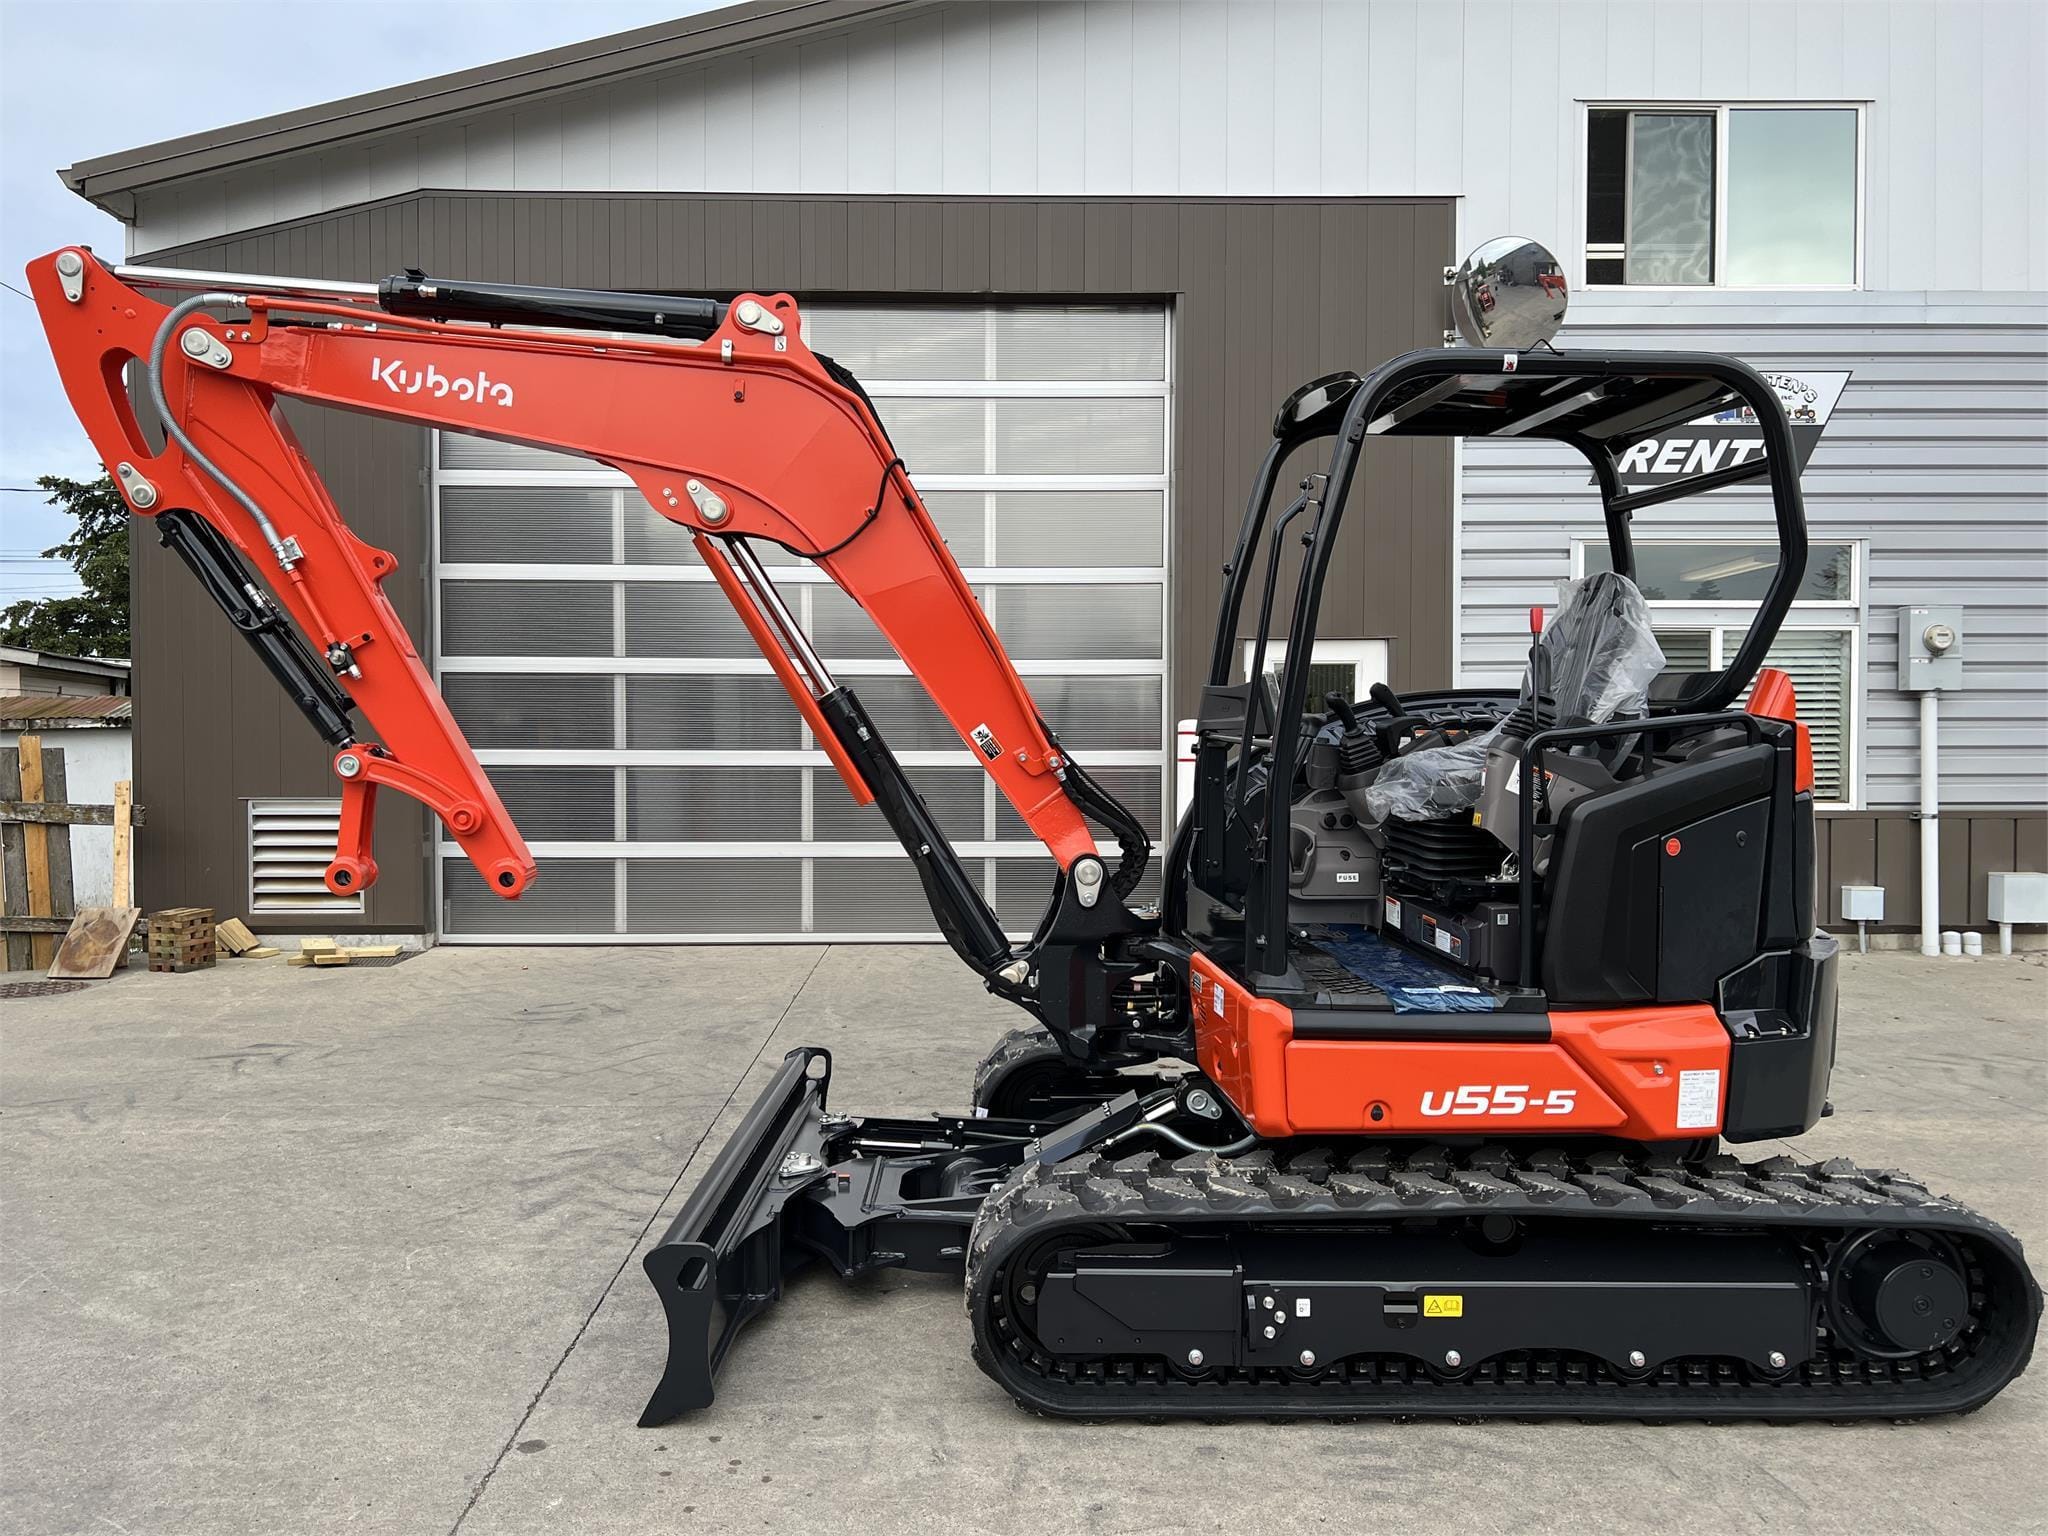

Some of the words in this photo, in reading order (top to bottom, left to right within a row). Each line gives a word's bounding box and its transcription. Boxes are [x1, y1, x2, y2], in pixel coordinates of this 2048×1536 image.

[371, 357, 514, 407] Kubota
[1760, 374, 1818, 403] TEN'S
[1618, 439, 1767, 473] RENT
[1420, 1085, 1577, 1116] U55-5
